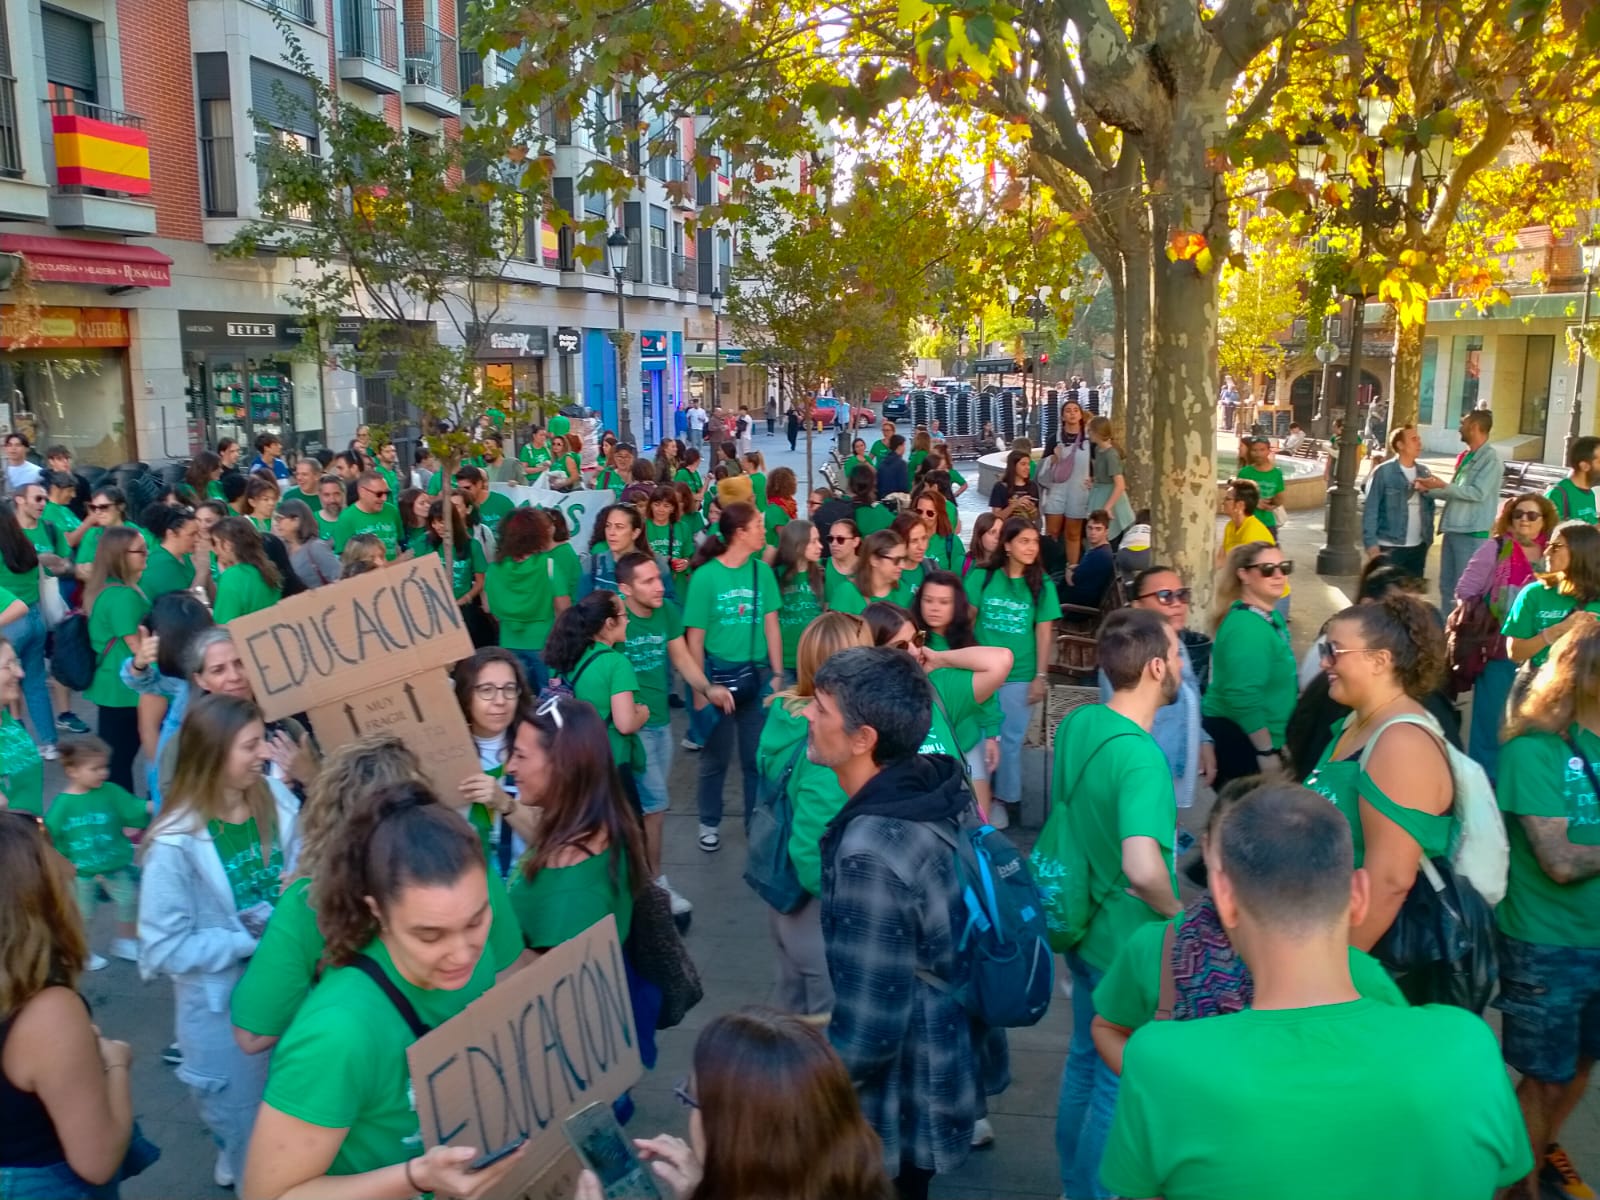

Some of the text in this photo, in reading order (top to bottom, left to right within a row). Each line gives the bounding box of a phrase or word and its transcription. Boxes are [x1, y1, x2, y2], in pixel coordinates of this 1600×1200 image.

[245, 566, 461, 696] EDUCACIÓN
[365, 697, 394, 712] MUY
[427, 937, 633, 1154] EDUCACIÓN
